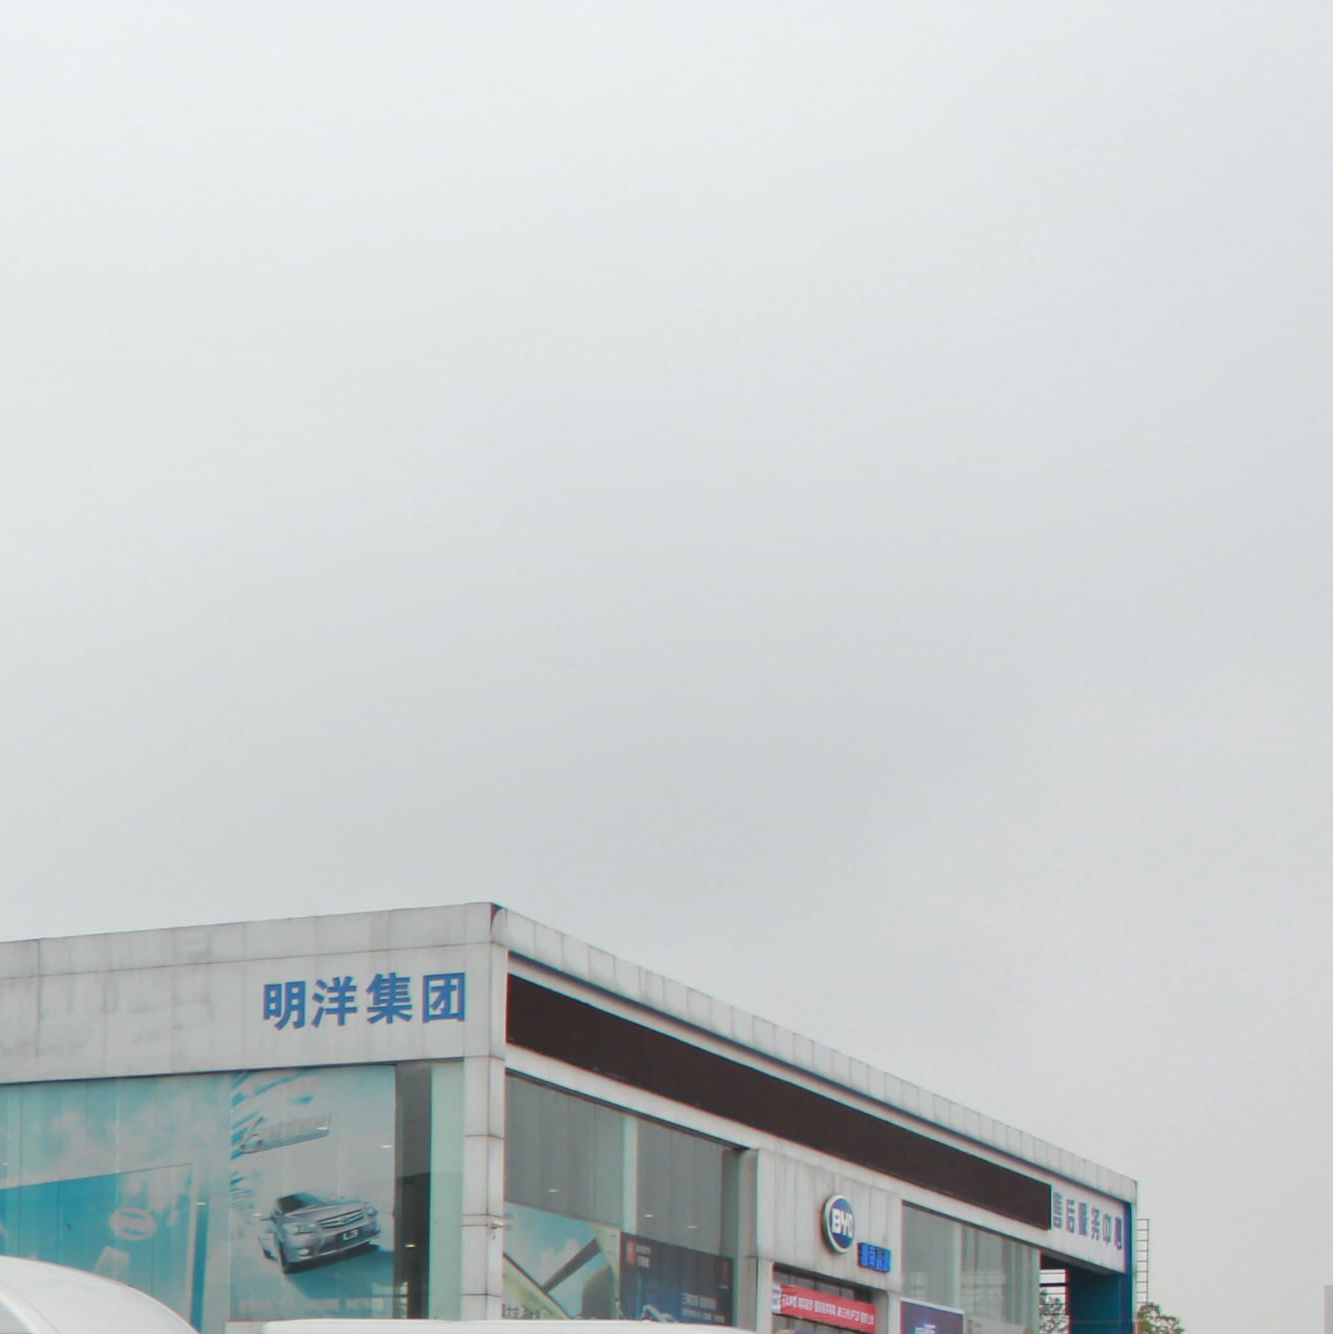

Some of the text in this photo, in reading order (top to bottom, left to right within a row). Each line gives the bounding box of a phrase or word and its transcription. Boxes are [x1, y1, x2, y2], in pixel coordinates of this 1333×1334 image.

[262, 971, 467, 1031] 明洋集团
[832, 1207, 854, 1238] BYD
